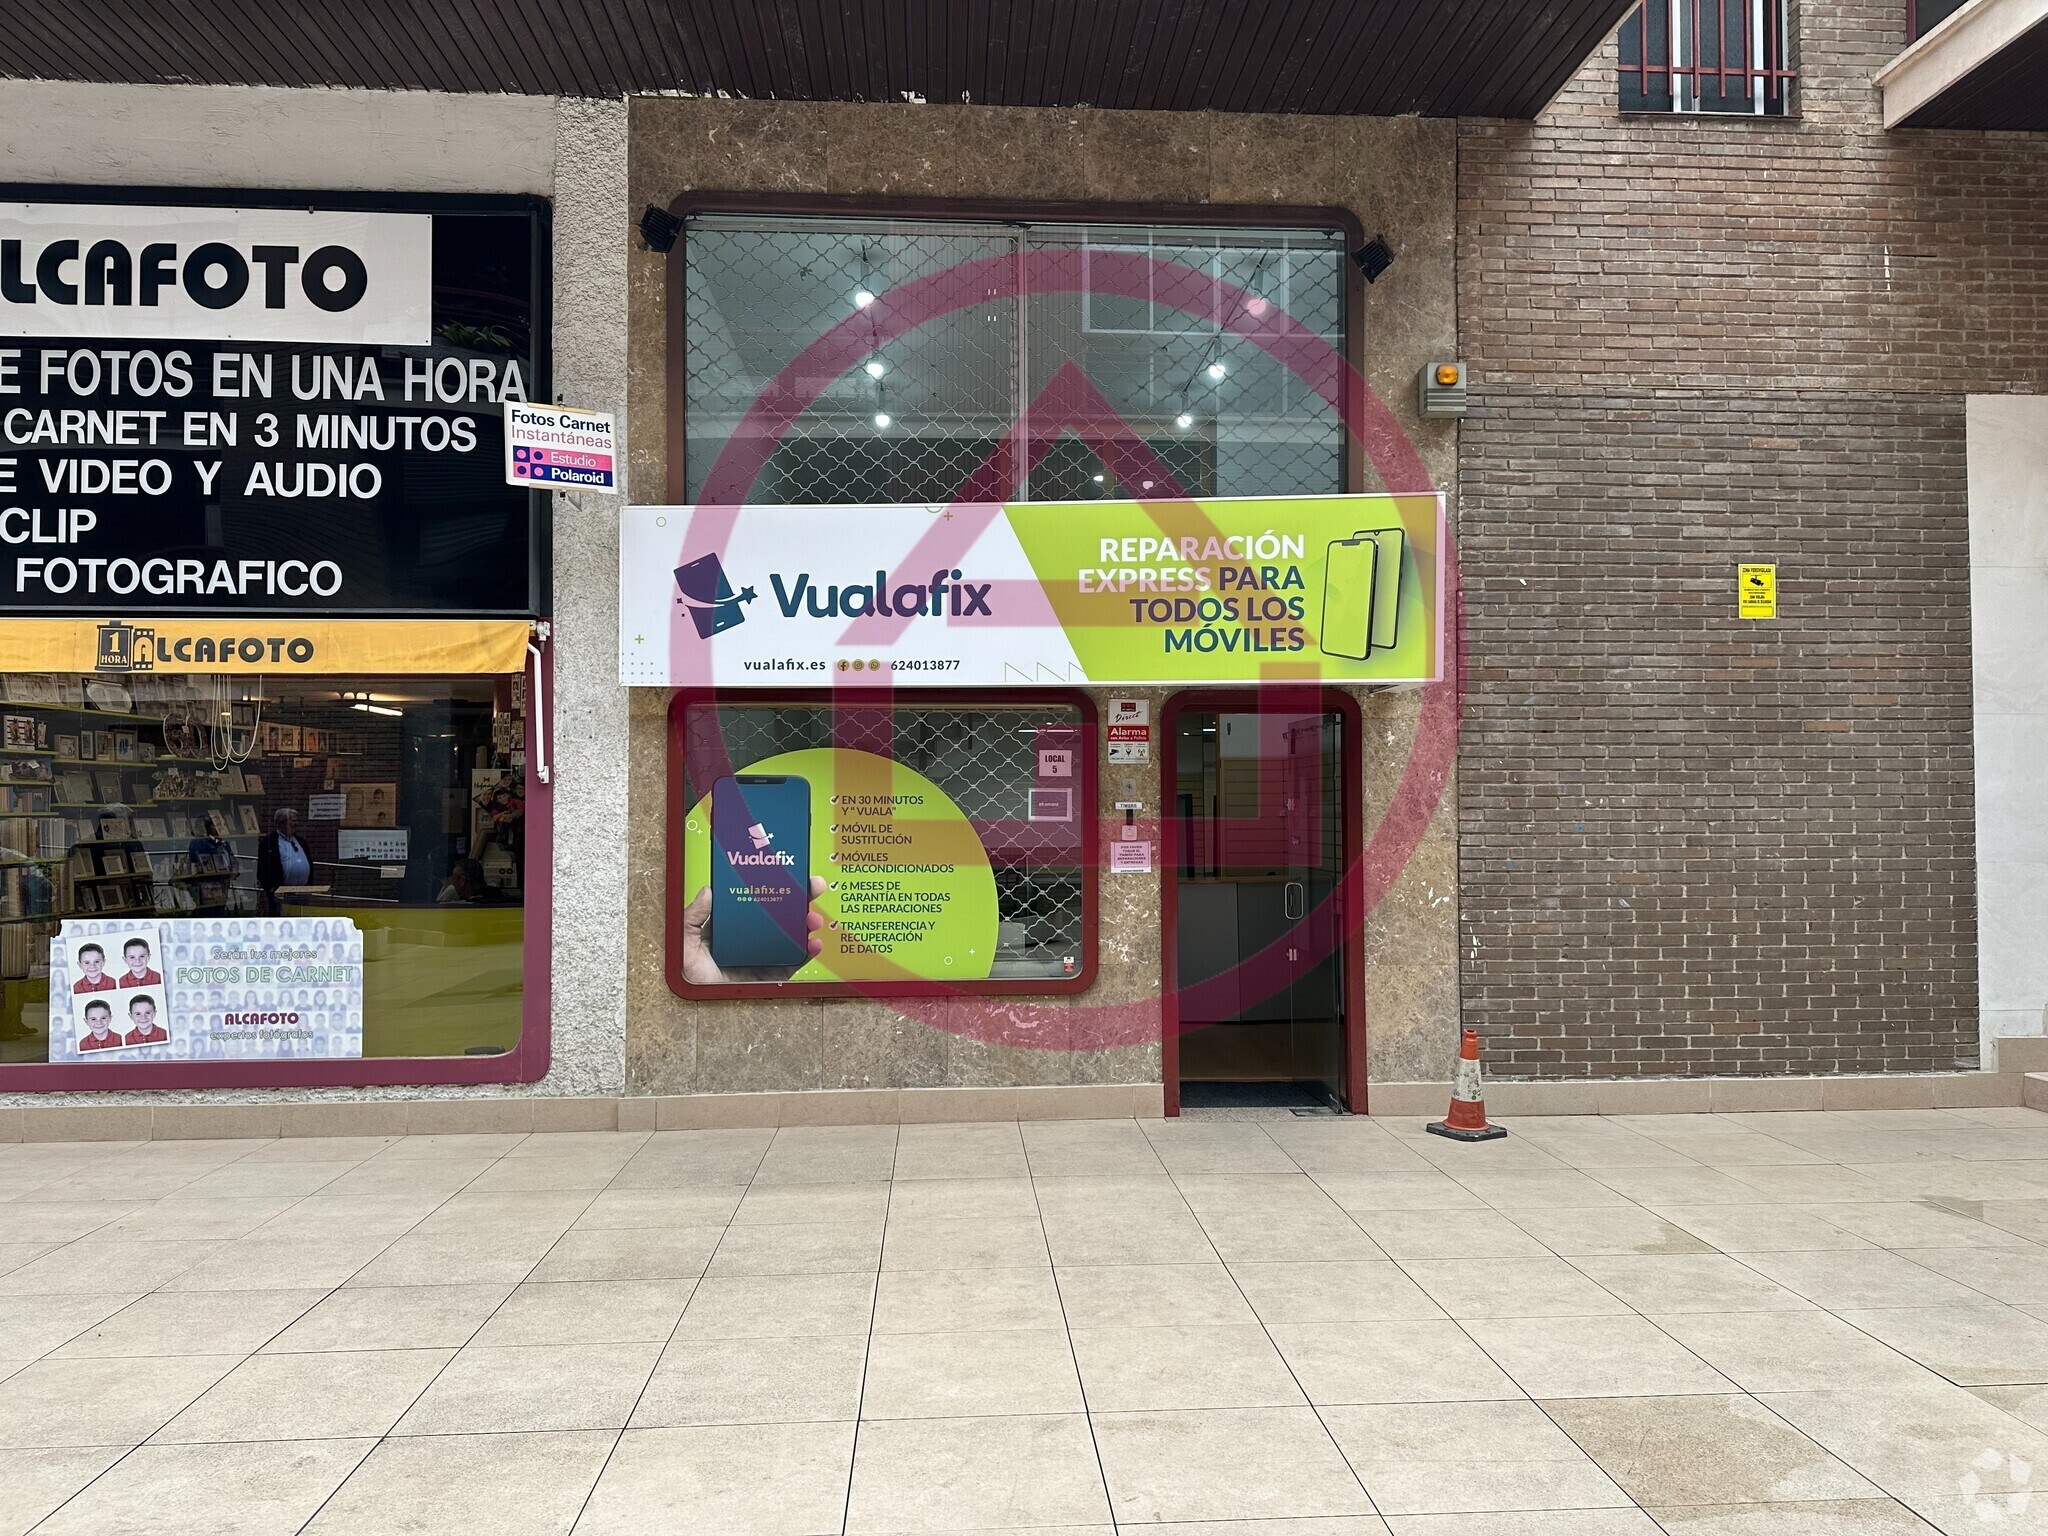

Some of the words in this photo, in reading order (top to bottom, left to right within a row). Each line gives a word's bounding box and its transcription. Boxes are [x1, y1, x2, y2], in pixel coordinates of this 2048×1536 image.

[0, 239, 368, 313] LCAFOTO
[40, 349, 193, 397] FOTOS
[212, 352, 273, 399] EN
[291, 354, 386, 401] UNA
[403, 357, 527, 403] HORA
[511, 409, 555, 427] Fotos
[559, 414, 611, 434] Carnet
[3, 408, 167, 445] CARNET
[183, 411, 237, 447] EN
[253, 413, 279, 448] 3
[296, 414, 477, 453] MINUTOS
[511, 425, 612, 449] Instantáneas
[550, 451, 597, 472] Estudio
[38, 459, 172, 496] VIDEO
[193, 460, 223, 495] Y
[243, 461, 382, 499] AUDIO
[551, 467, 605, 484] Polaroid
[0, 507, 97, 544] CLIP
[1100, 529, 1305, 563] REPARACIÓN
[16, 557, 343, 597] FOTOGRAFICO
[1078, 567, 1212, 593] EXPRESS
[1219, 565, 1306, 591] PARA
[769, 568, 993, 618] Vualafix
[1129, 596, 1240, 623] TODOS
[1247, 596, 1305, 621] LOS
[109, 631, 121, 653] 1
[1164, 623, 1305, 653] MÓVILES
[101, 655, 128, 664] HORA
[743, 658, 827, 671] vualafix.es
[890, 659, 961, 671] 624013877
[1110, 726, 1147, 736] Alarma
[1045, 754, 1065, 763] LOCAL
[1052, 765, 1058, 774] 5
[842, 795, 857, 805] EN
[858, 795, 871, 805] 30
[873, 795, 924, 805] MINUTOS
[841, 806, 850, 816] Y
[841, 822, 877, 833] MÓVIL
[879, 824, 893, 833] DE
[841, 833, 912, 845] SUSTITUCIÓN
[727, 850, 795, 866] Vualafix
[841, 850, 889, 862] MÓVILES
[841, 864, 955, 874] REACONDICIONADOS
[729, 885, 791, 895] vualafix.es
[841, 881, 848, 891] 6
[850, 881, 884, 891] MESES
[887, 881, 901, 891] DE
[841, 891, 897, 902] GARANTÍA
[899, 892, 912, 901] EN
[914, 892, 951, 902] TODAS
[841, 904, 860, 914] LAS
[862, 903, 942, 914] REPARACIONES
[841, 921, 927, 931] TRANSFERENCIA
[928, 921, 936, 931] Y
[841, 931, 923, 943] RECUPERACIÓN
[213, 947, 248, 960] Serán
[250, 948, 268, 960] tus
[270, 949, 318, 961] mejores
[841, 944, 855, 954] DE
[857, 944, 893, 954] DATOS
[177, 967, 240, 984] FOTOS
[246, 967, 271, 983] DE
[276, 965, 353, 983] CARNET
[224, 1012, 300, 1025] ALCAFOTO
[210, 1030, 258, 1042] expertos
[259, 1029, 314, 1041] fotógrafos
